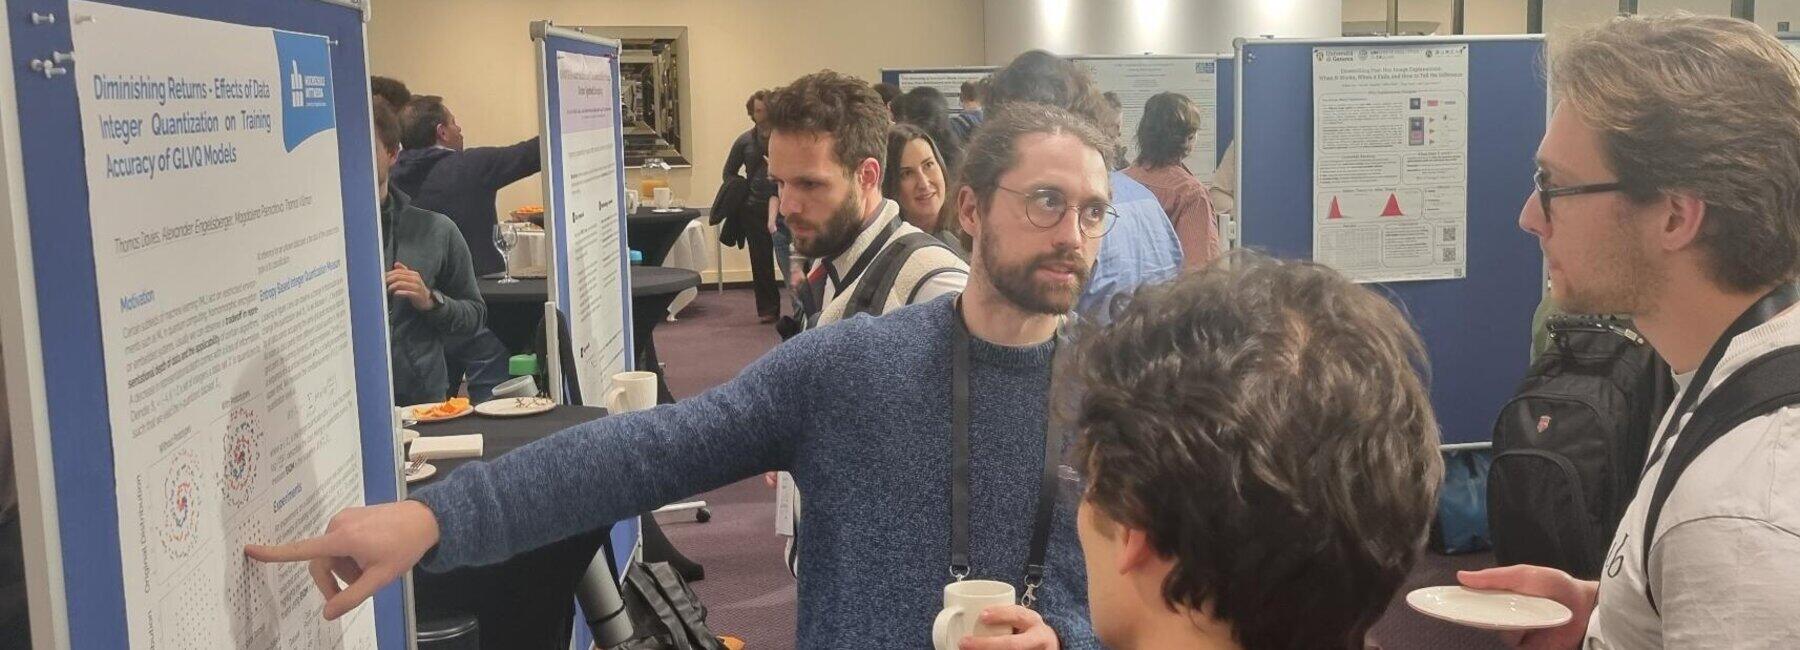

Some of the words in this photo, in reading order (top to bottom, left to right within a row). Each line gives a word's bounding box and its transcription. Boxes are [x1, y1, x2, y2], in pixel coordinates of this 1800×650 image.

[93, 74, 166, 106] Diminishing
[168, 77, 208, 100] Returns
[214, 78, 244, 100] Effects
[244, 79, 252, 98] of
[253, 79, 271, 99] Data
[99, 114, 143, 145] Integer
[152, 110, 219, 136] Quantization
[225, 115, 236, 131] on
[241, 109, 272, 133] Training
[107, 153, 156, 180] Accuracy
[158, 147, 171, 172] of
[173, 145, 203, 171] GLVQ
[203, 142, 237, 167] Models
[120, 289, 155, 313] Motivation
